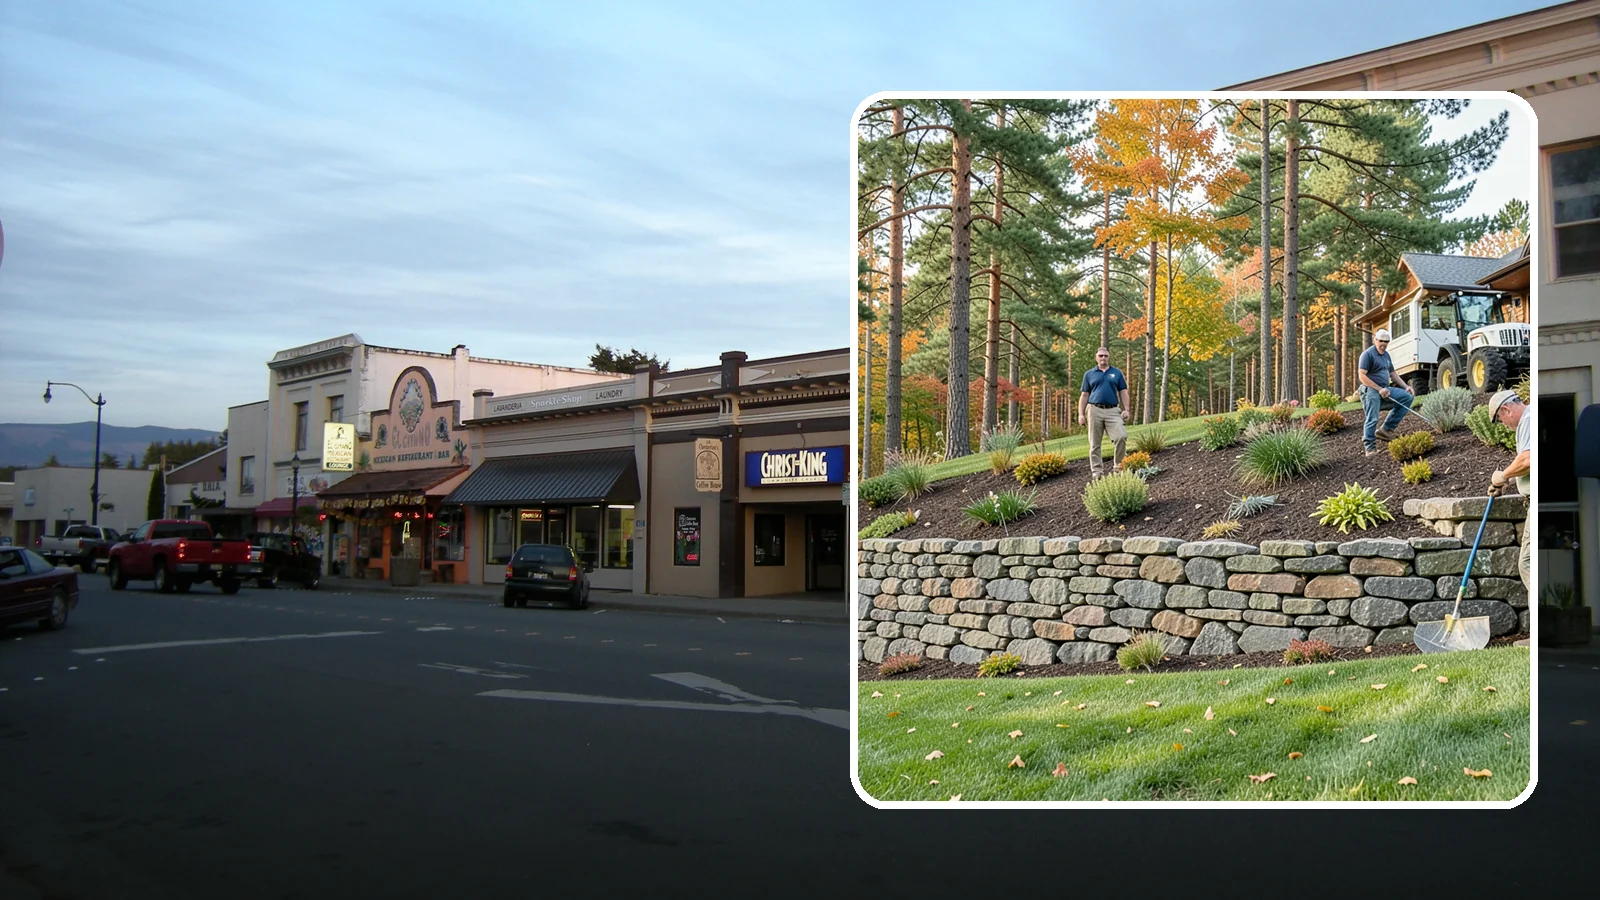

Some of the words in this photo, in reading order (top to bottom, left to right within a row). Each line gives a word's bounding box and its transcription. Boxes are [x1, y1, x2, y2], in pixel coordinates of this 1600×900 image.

[596, 389, 623, 400] LAUNDRY
[493, 402, 522, 412] LAVANDERIA
[530, 396, 560, 409] Sparkle
[561, 394, 582, 405] Shop
[398, 451, 433, 462] RESTAURANT
[438, 450, 450, 459] BAR
[761, 452, 797, 478] CHRIST
[800, 450, 827, 476] KING
